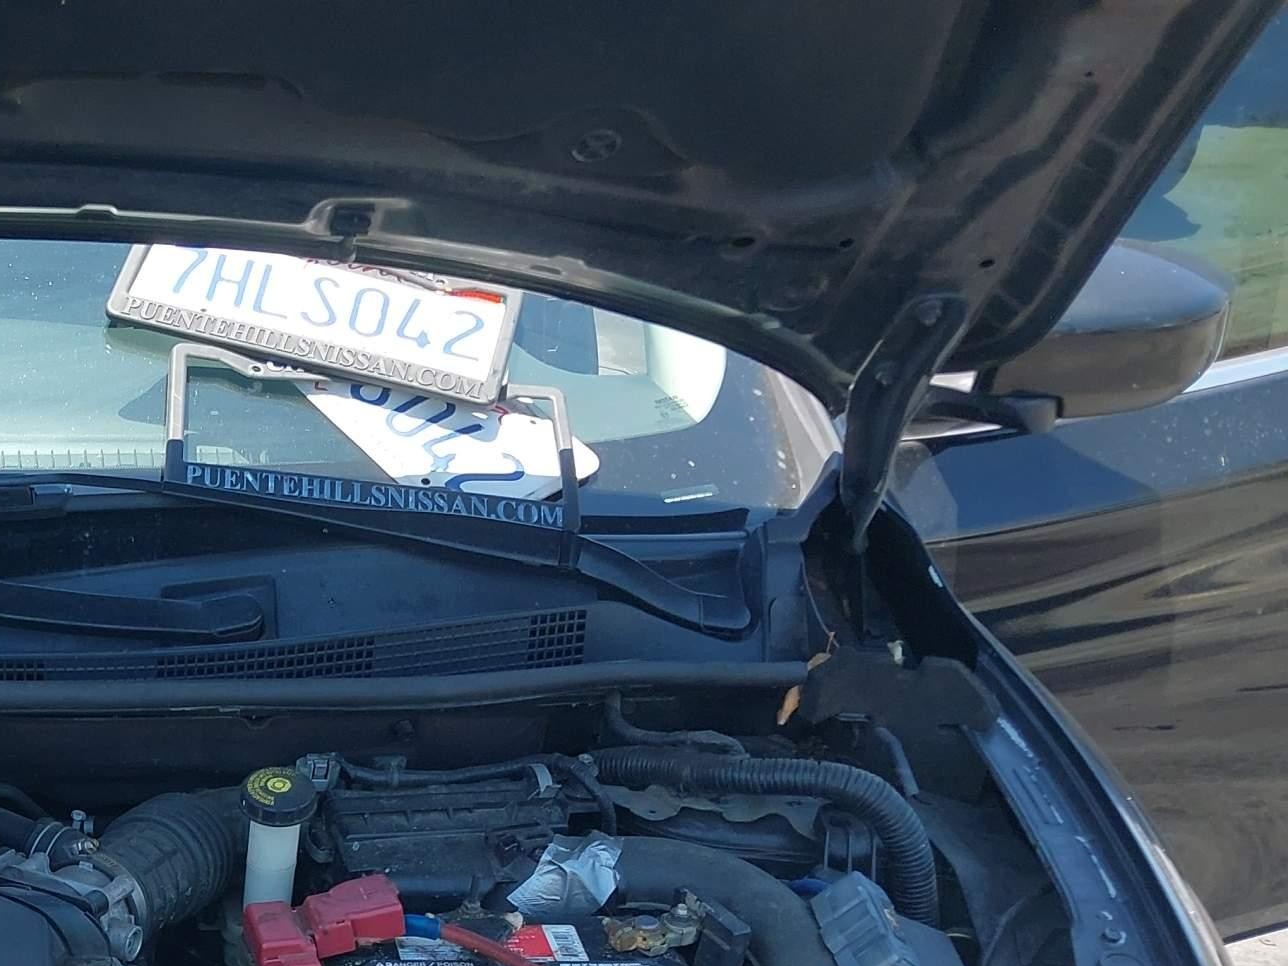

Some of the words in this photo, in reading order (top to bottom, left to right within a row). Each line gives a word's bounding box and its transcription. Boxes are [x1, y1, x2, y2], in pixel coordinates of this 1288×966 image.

[121, 296, 486, 401] PUENTEHILLSNISSAN.COM
[171, 247, 486, 362] 7HLS042
[185, 463, 566, 528] PUENTEHILLSNISSAN.COM
